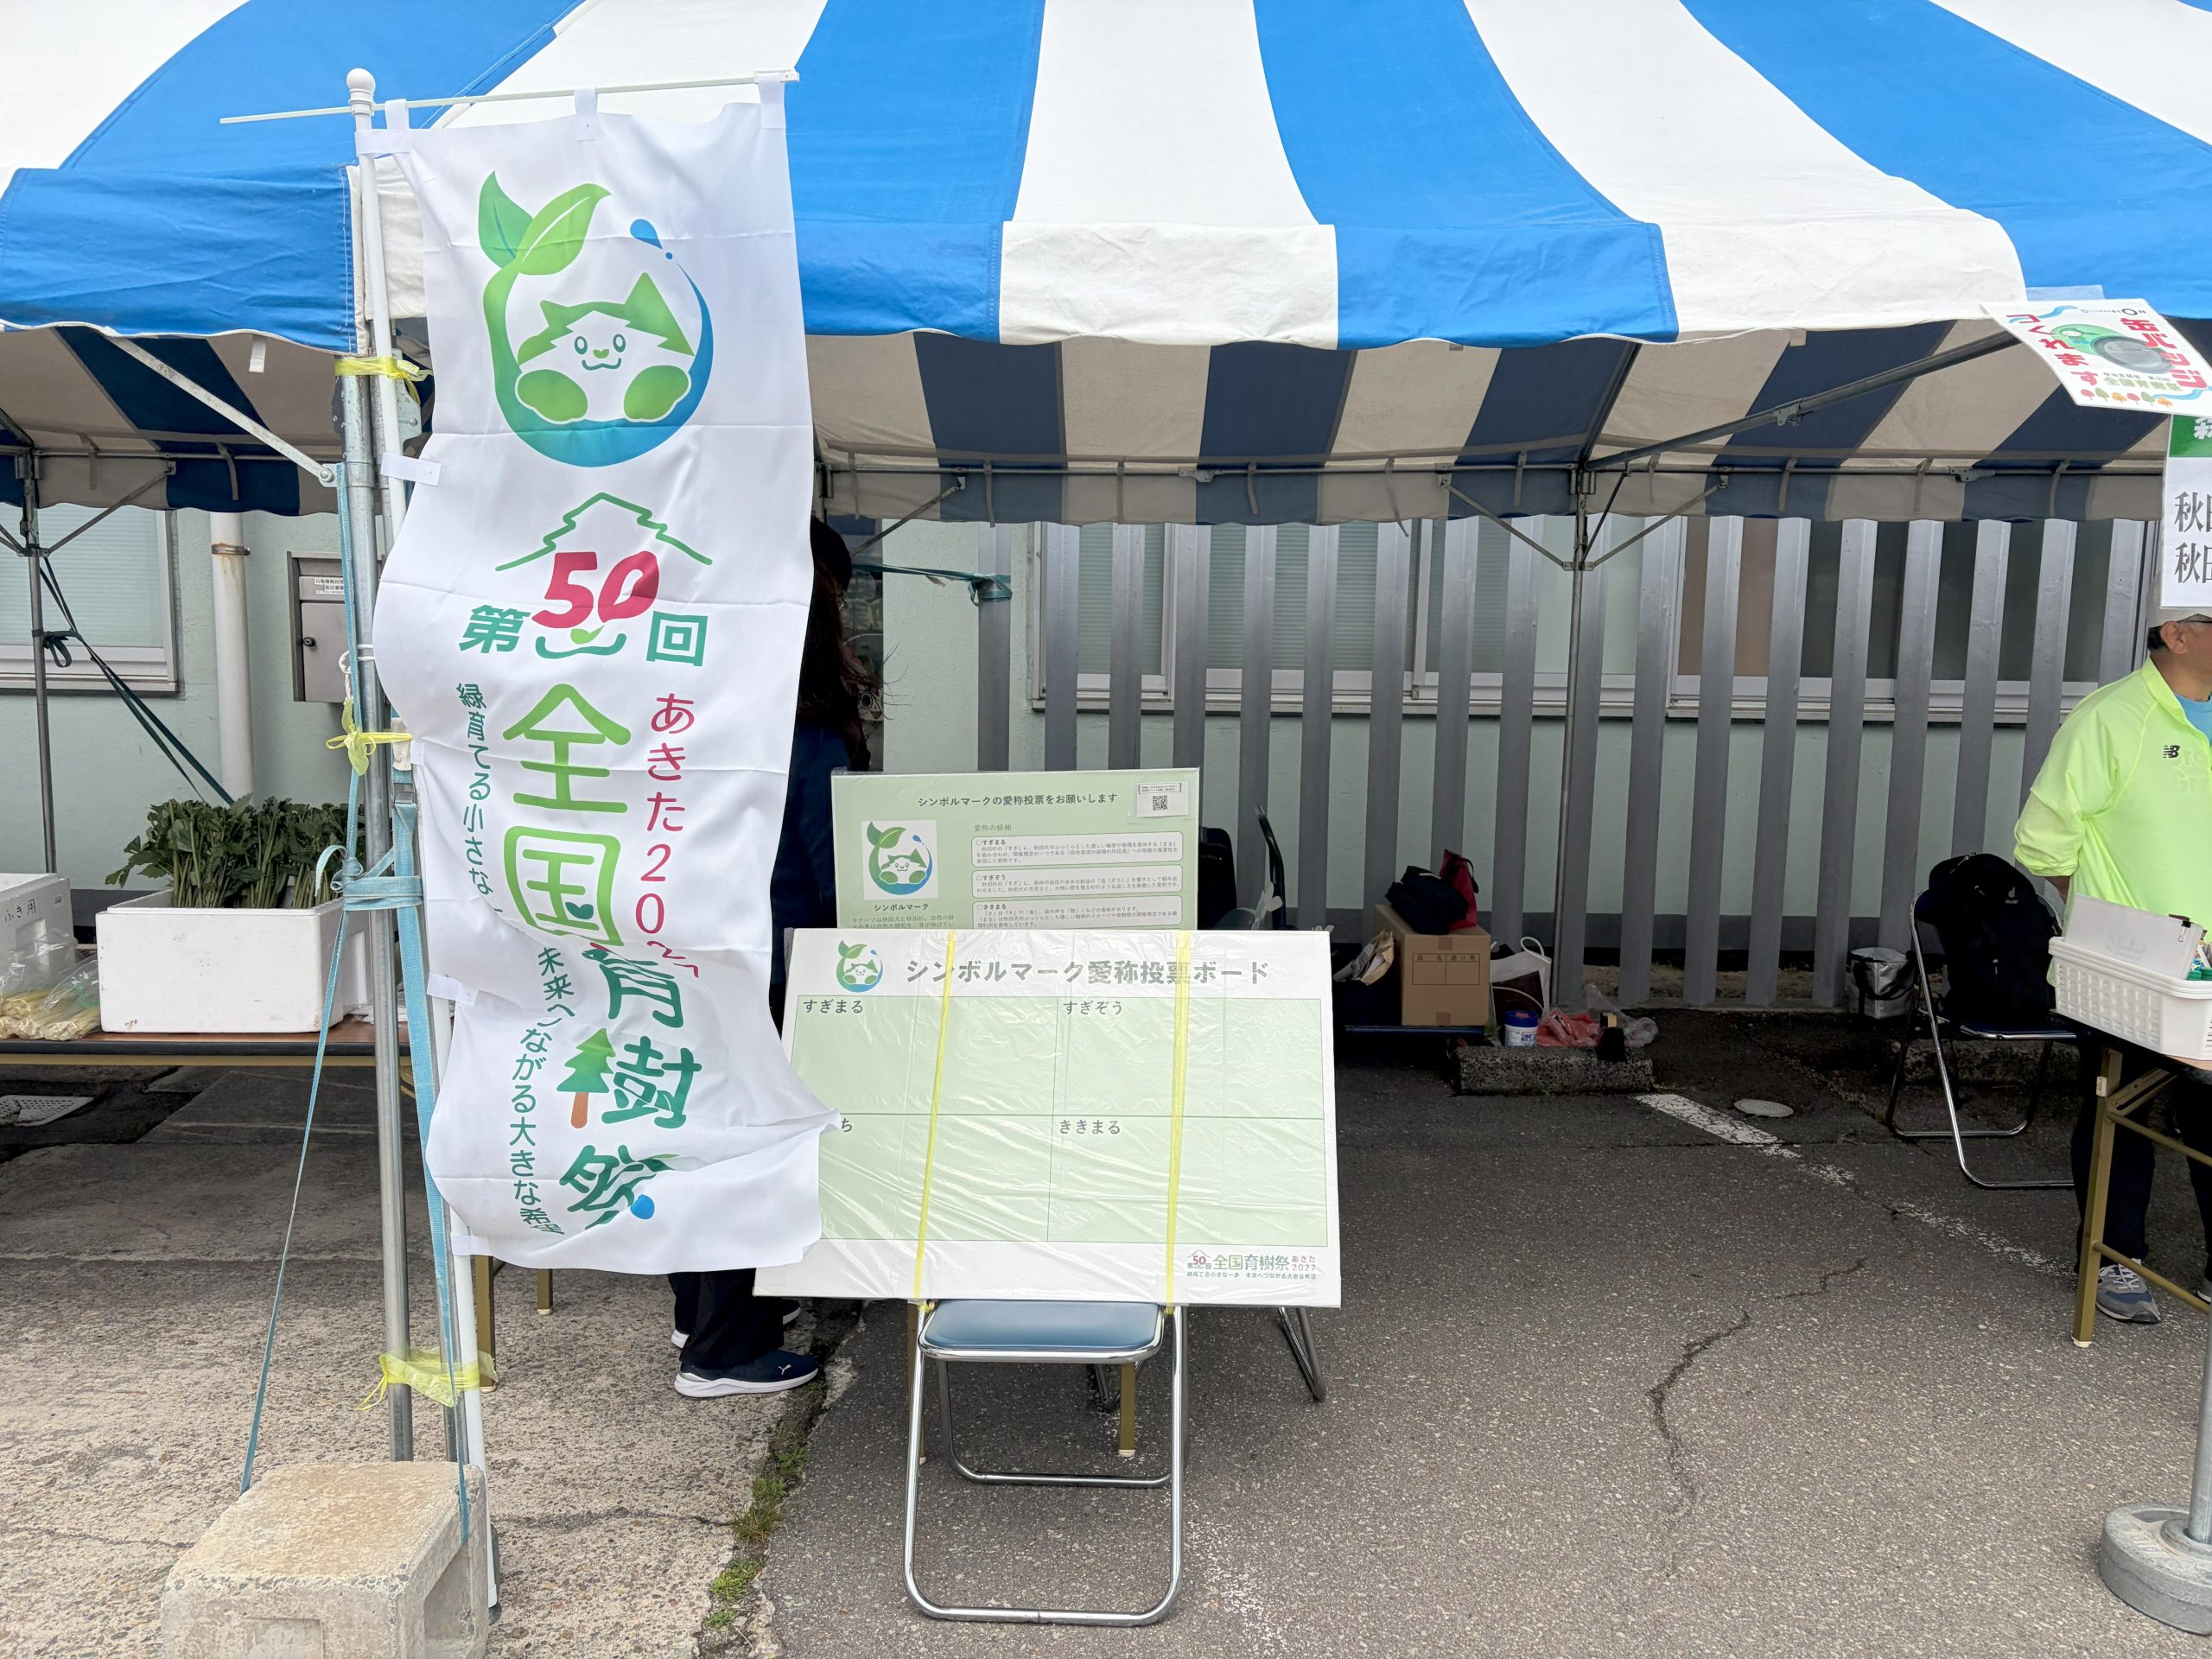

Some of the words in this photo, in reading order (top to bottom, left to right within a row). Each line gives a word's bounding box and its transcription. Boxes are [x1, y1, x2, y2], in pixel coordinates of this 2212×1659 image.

[2174, 491, 2212, 532] 秋
[455, 683, 504, 912] 緑育てる小さな
[918, 792, 1118, 807] シンボルマークの愛称投票をお願いします
[874, 903, 929, 912] シンボルマーク
[906, 960, 1268, 985] シンボルマーク愛称投票ボード
[804, 999, 864, 1014] すぎまる
[1063, 1000, 1123, 1015] すぎぞう
[1059, 1120, 1121, 1135] ききまる
[1213, 1254, 1290, 1271] 全国育樹祭
